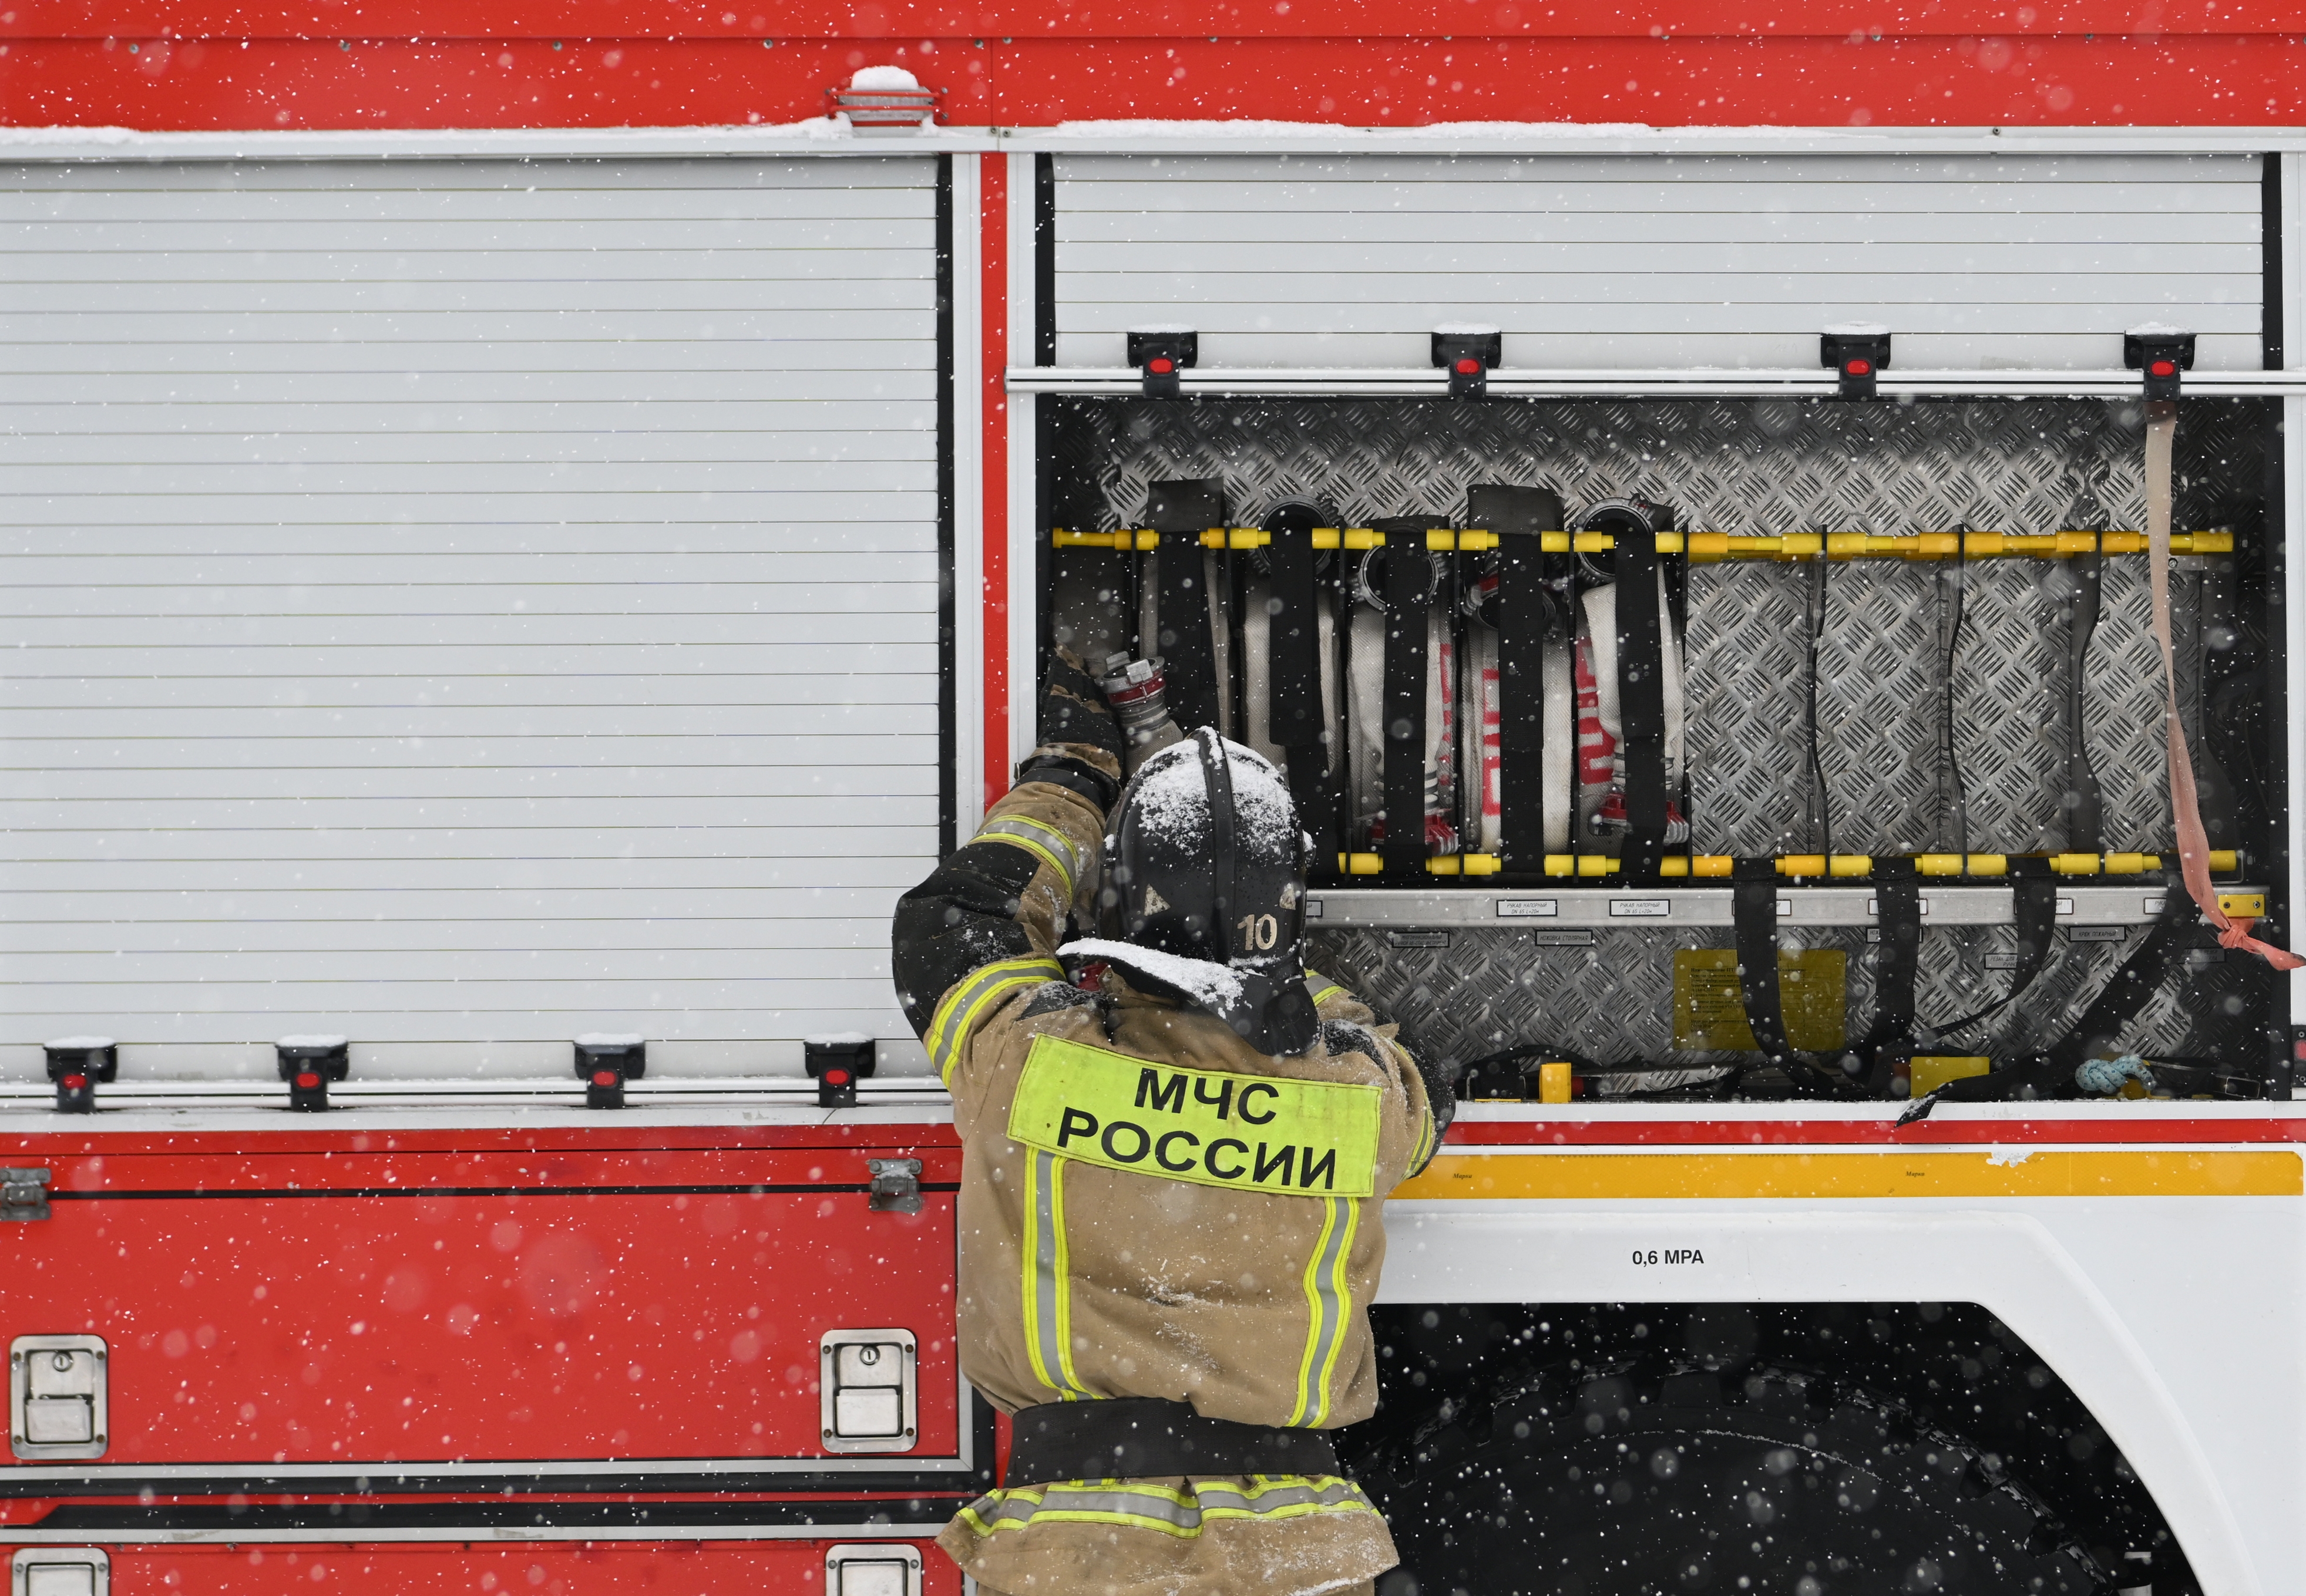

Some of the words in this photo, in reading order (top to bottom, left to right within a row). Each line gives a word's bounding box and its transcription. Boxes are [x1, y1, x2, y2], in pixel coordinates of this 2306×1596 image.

[1237, 914, 1278, 950] 10
[1134, 1068, 1279, 1124] МЧС
[1057, 1106, 1336, 1190] РОССИИ
[1632, 1251, 1658, 1268] 0,6
[1665, 1250, 1704, 1264] MPA
